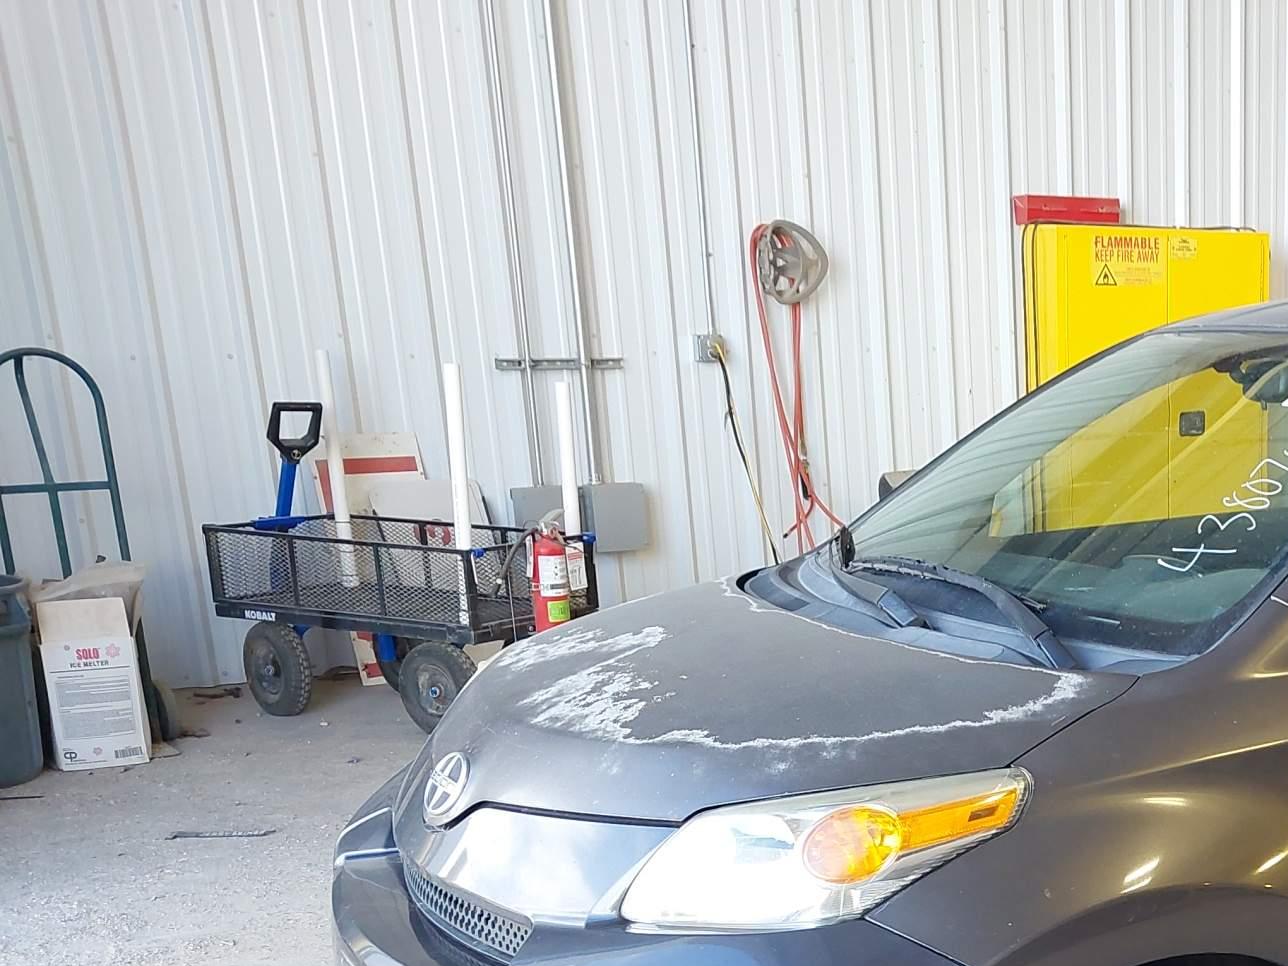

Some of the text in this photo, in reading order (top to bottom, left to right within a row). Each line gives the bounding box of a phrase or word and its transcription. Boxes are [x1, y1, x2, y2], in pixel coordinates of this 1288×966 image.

[1094, 235, 1160, 249] FLAMMABLE
[1095, 249, 1160, 264] KEEP FIRE AWAY
[244, 609, 276, 621] KOBALT
[75, 647, 100, 660] SOLO
